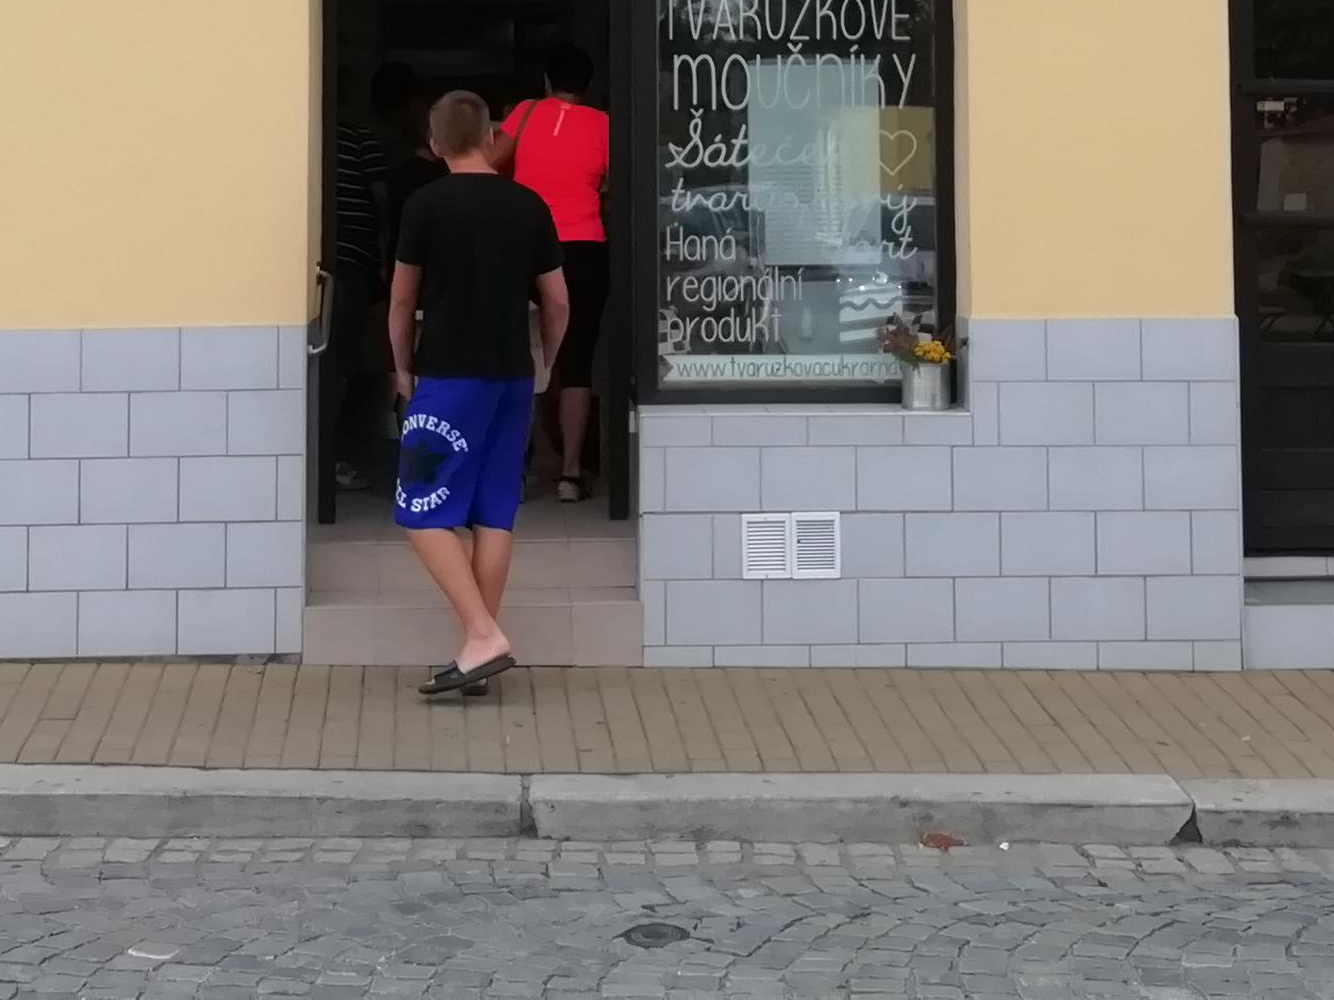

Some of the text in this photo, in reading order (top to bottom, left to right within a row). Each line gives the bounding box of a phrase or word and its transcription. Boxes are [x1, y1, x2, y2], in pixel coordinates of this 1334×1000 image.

[666, 223, 737, 261] Haná
[667, 265, 803, 311] regionální
[667, 306, 783, 343] produkt
[401, 413, 469, 453] ONVERSE
